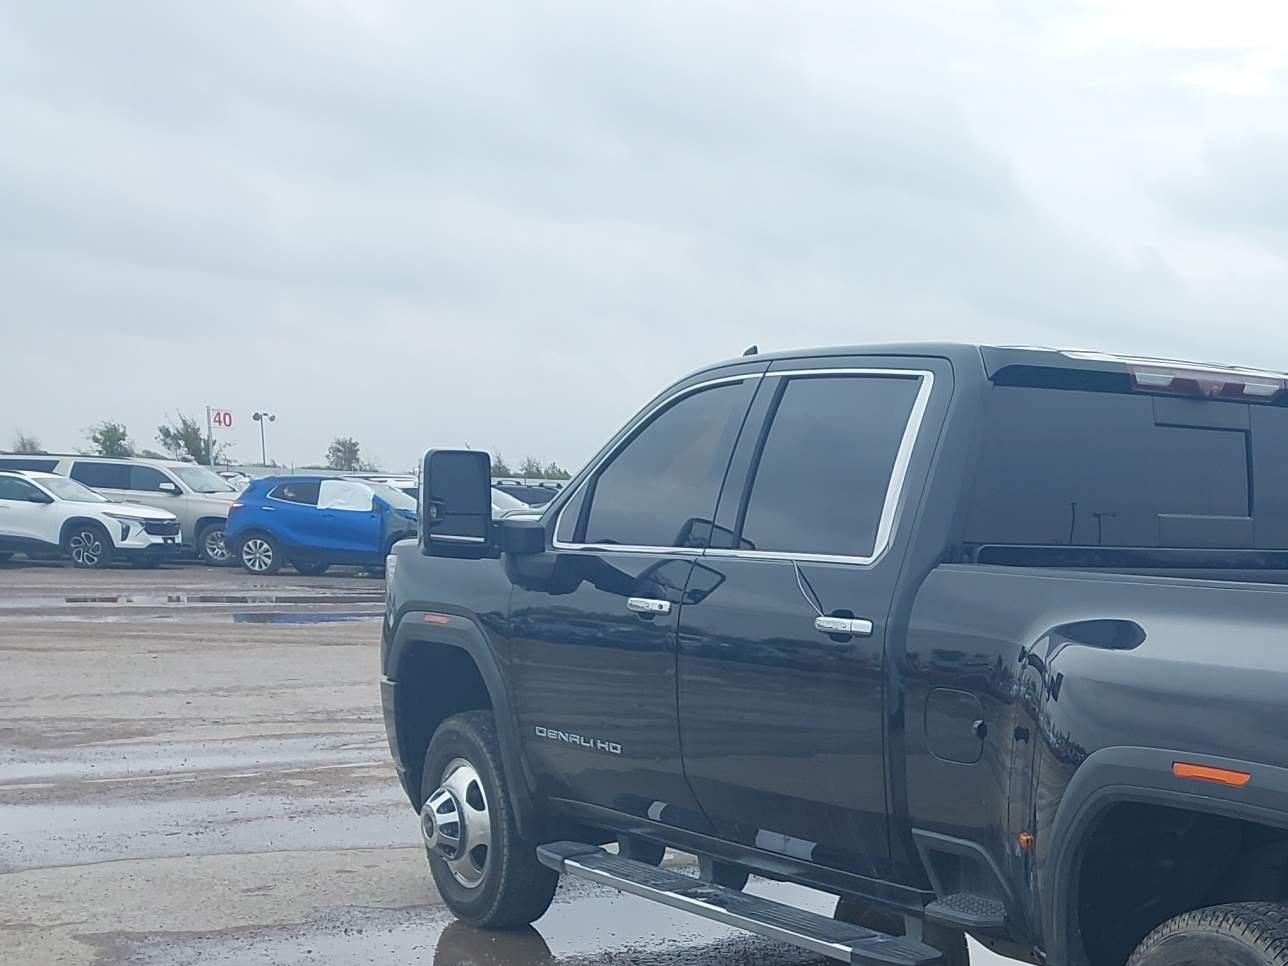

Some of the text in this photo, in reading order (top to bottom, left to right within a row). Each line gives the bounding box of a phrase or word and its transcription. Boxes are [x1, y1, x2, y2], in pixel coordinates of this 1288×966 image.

[213, 411, 232, 427] 40
[535, 726, 622, 754] DENALI HD
